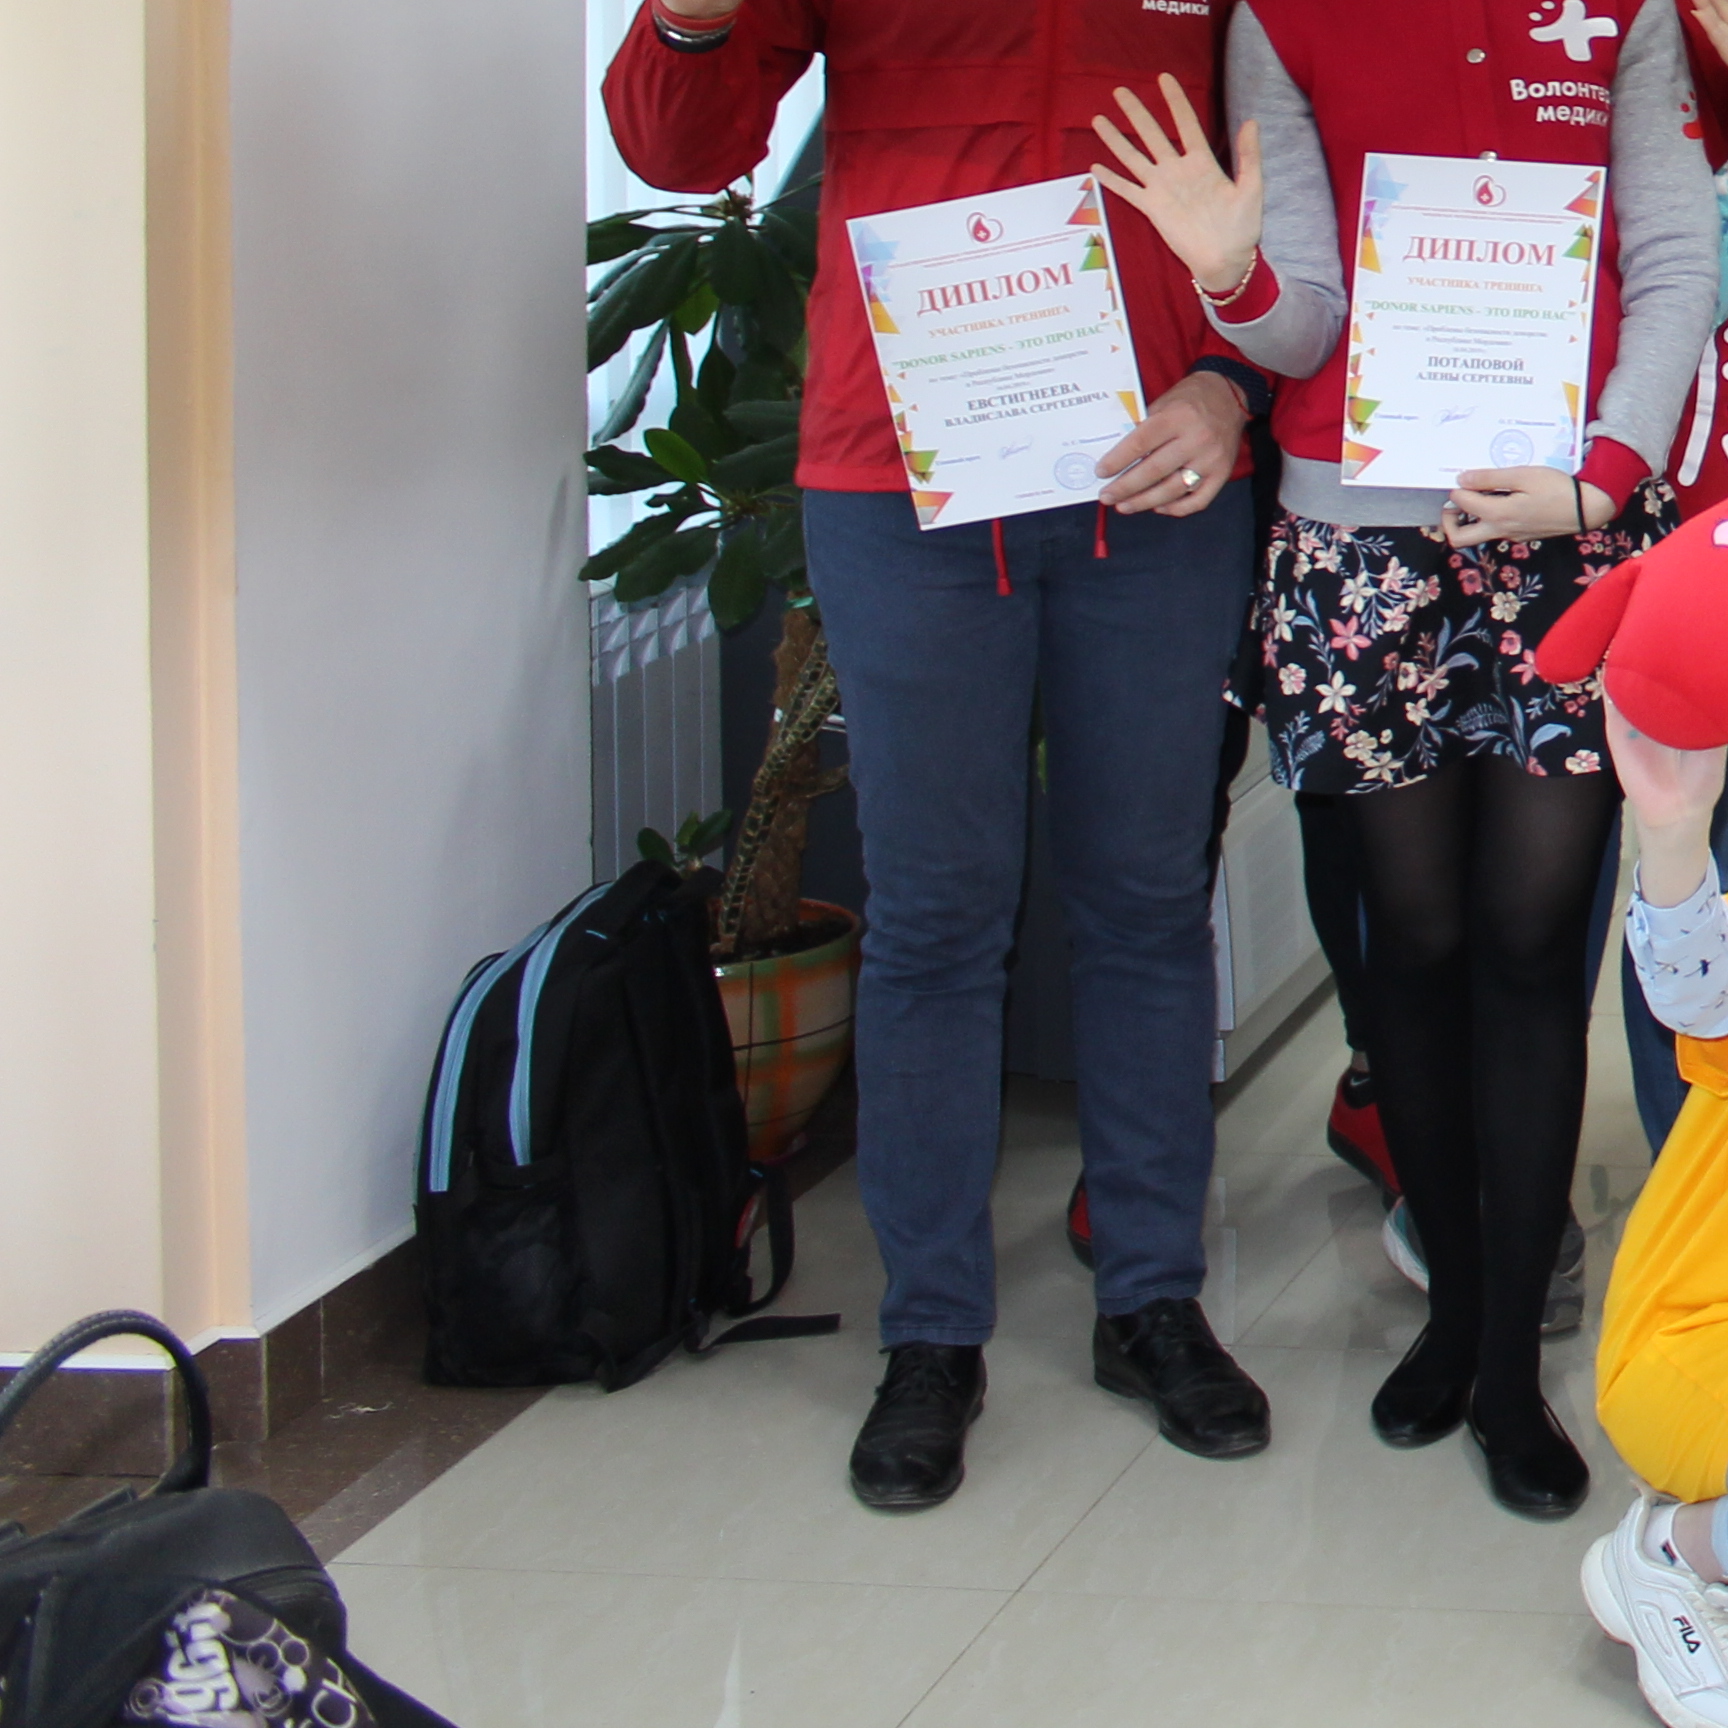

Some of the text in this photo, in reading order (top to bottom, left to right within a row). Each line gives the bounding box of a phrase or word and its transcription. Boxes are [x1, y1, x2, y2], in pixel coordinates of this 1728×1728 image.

[1510, 78, 1611, 107] Волонте
[1403, 236, 1555, 266] ДИПЛОМ
[916, 262, 1074, 315] ДИПЛОМ
[1407, 276, 1479, 289] УЧАСТНИКА
[1420, 303, 1473, 315] SAPIENS
[928, 317, 1003, 338] УЧАСТНИКА
[951, 343, 1004, 360] SAPIENS
[1428, 354, 1523, 370] ПОТАПОВОЙ
[1417, 370, 1534, 385] АЛЕНЫ СЕРГЕЕВНЫ
[967, 381, 1080, 411] ЕВСТИГНЕЕВА
[945, 391, 1108, 428] ВЛАДИСЛАВА СЕРГЕЕВИЧА
[1672, 1615, 1702, 1654] FILA
